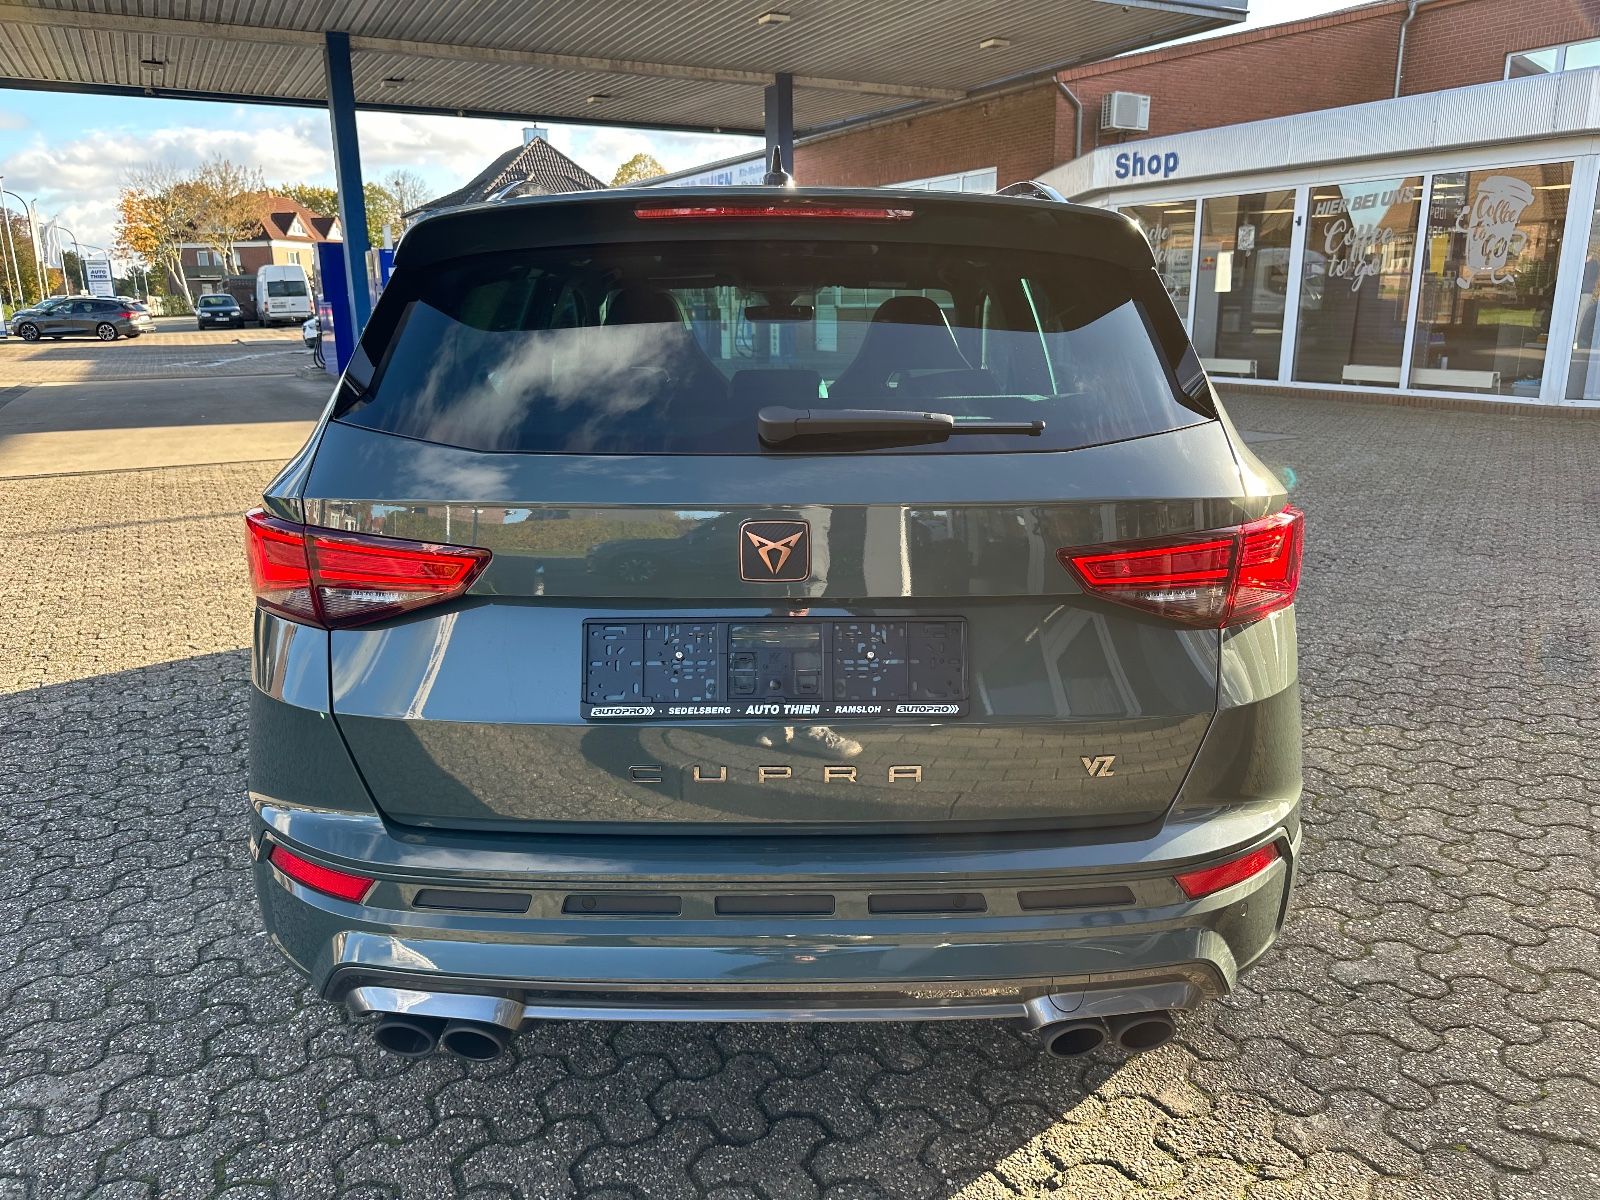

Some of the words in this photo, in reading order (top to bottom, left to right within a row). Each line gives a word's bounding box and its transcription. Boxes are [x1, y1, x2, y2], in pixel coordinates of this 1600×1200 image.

[1115, 151, 1179, 179] Shop
[1315, 200, 1349, 216] HIER
[1351, 193, 1379, 211] BEI
[1381, 187, 1415, 206] UNS
[1477, 194, 1516, 225] Coffee
[1324, 219, 1393, 264] Coffee
[1328, 255, 1348, 277] to
[1351, 259, 1381, 292] go
[668, 707, 731, 715] SEDELSBERG
[745, 705, 780, 715] AUTO
[784, 705, 820, 714] THIEN
[834, 705, 882, 714] RAMSLOH
[628, 764, 922, 784] CUPRA
[1080, 754, 1116, 777] VZ
